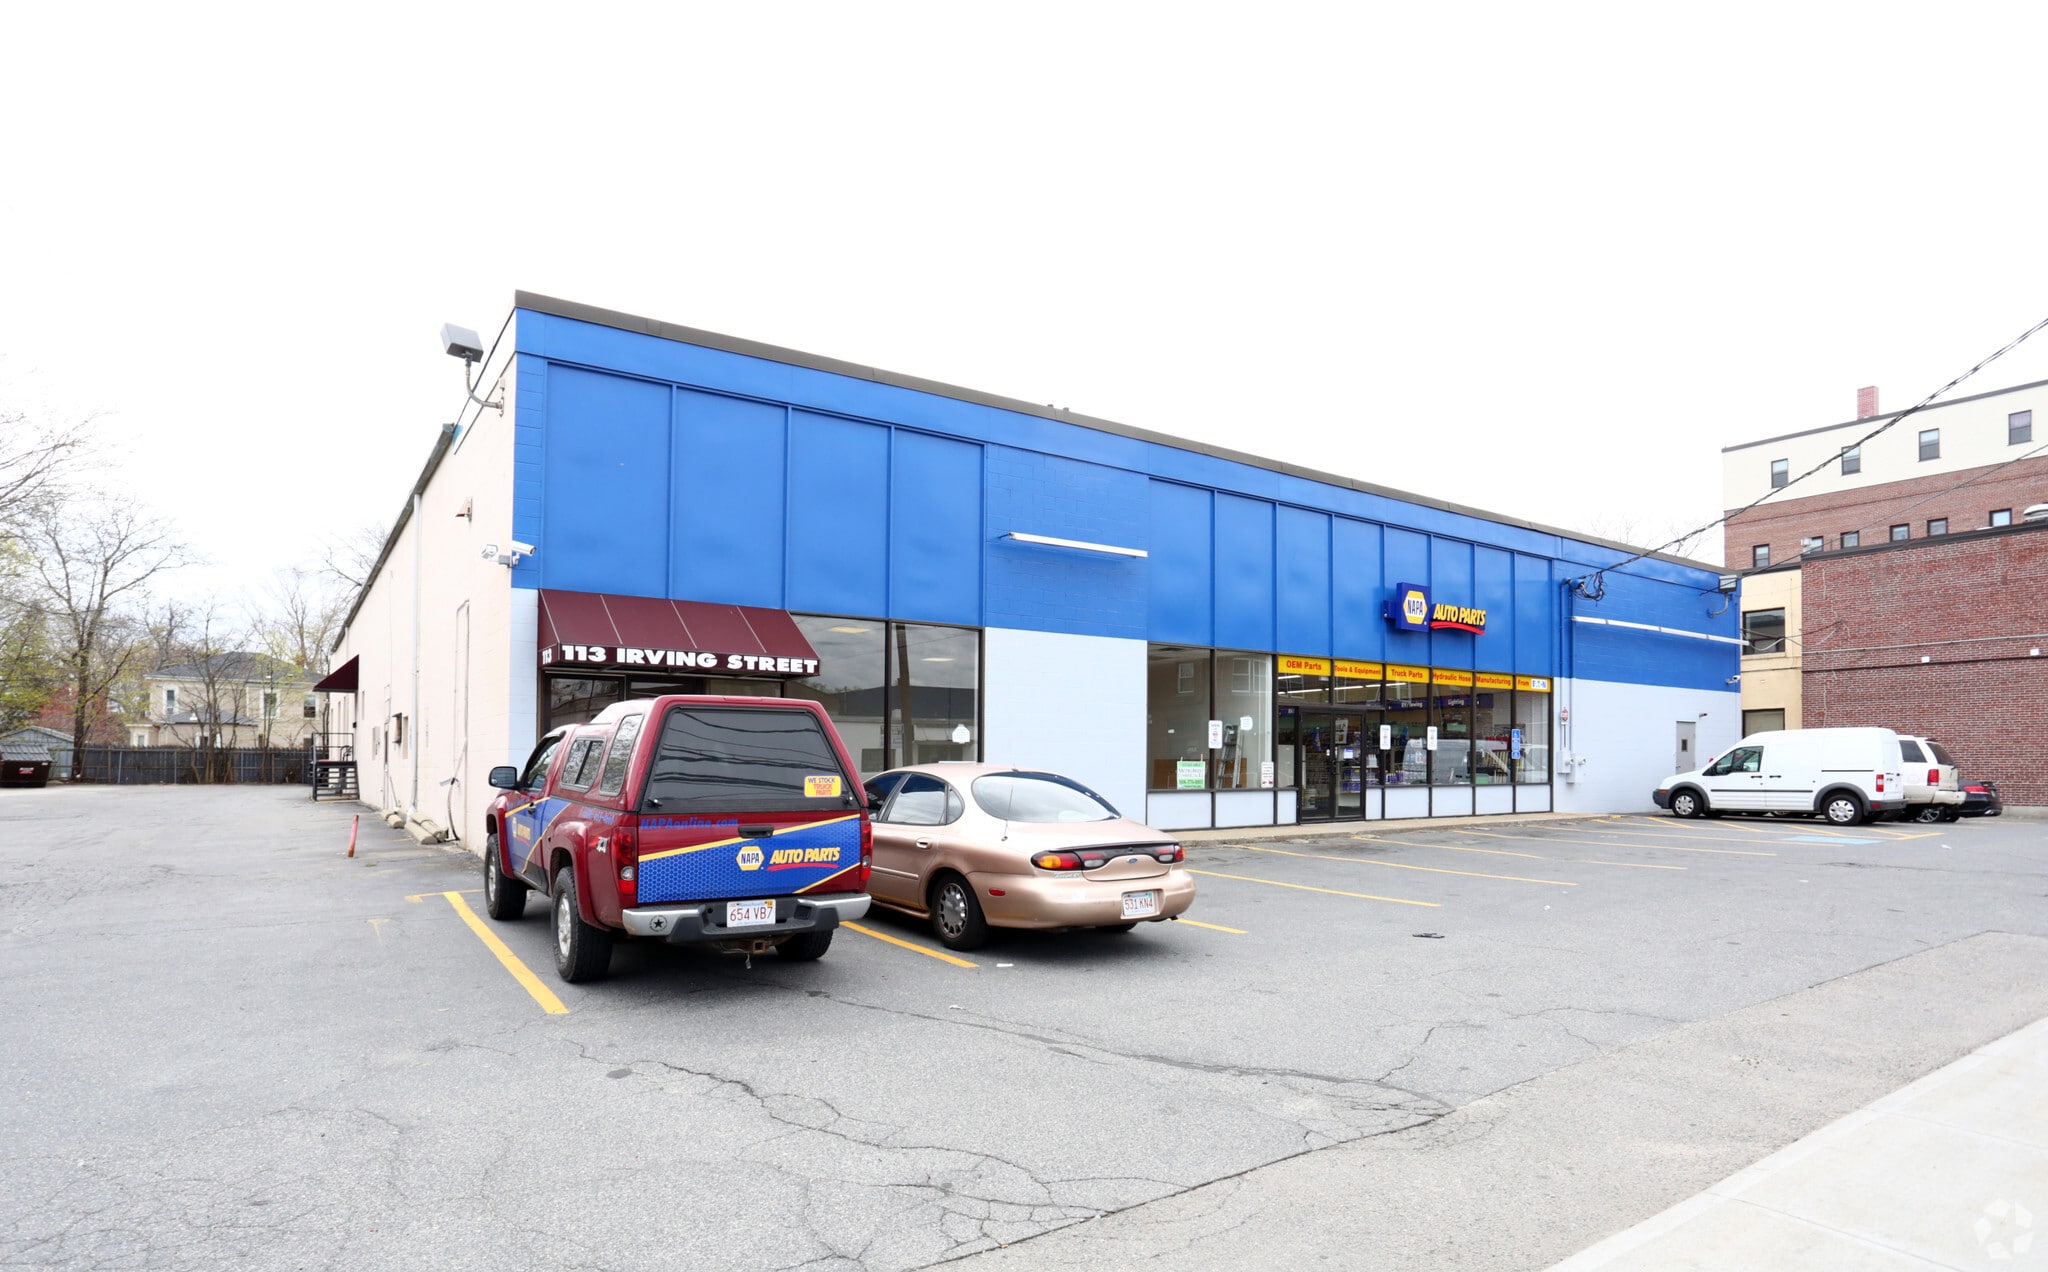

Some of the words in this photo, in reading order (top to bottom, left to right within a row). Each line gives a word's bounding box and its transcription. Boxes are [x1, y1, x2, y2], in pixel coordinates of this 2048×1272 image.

[1407, 599, 1424, 616] NAPA
[1433, 603, 1458, 622] AUTO
[1458, 607, 1486, 626] PARTS
[561, 645, 607, 662] 113
[616, 647, 718, 668] IRVING
[727, 654, 818, 674] STREET
[1286, 660, 1302, 669] OEM
[1304, 661, 1322, 671] Parts
[1334, 664, 1348, 673] Tools
[1354, 666, 1382, 676] Equipment
[1391, 668, 1407, 677] Truck
[1408, 670, 1423, 679] Parts
[1432, 671, 1457, 681] Hydraulic
[1458, 674, 1472, 682] Hose
[1476, 675, 1512, 687] Manufacturing
[1517, 678, 1530, 687] From
[640, 817, 739, 830] NAPAonline.com
[741, 852, 760, 865] NAPA
[769, 848, 804, 865] AUTO
[804, 847, 841, 863] PARTS
[730, 907, 750, 921] 654
[753, 906, 773, 920] VB7
